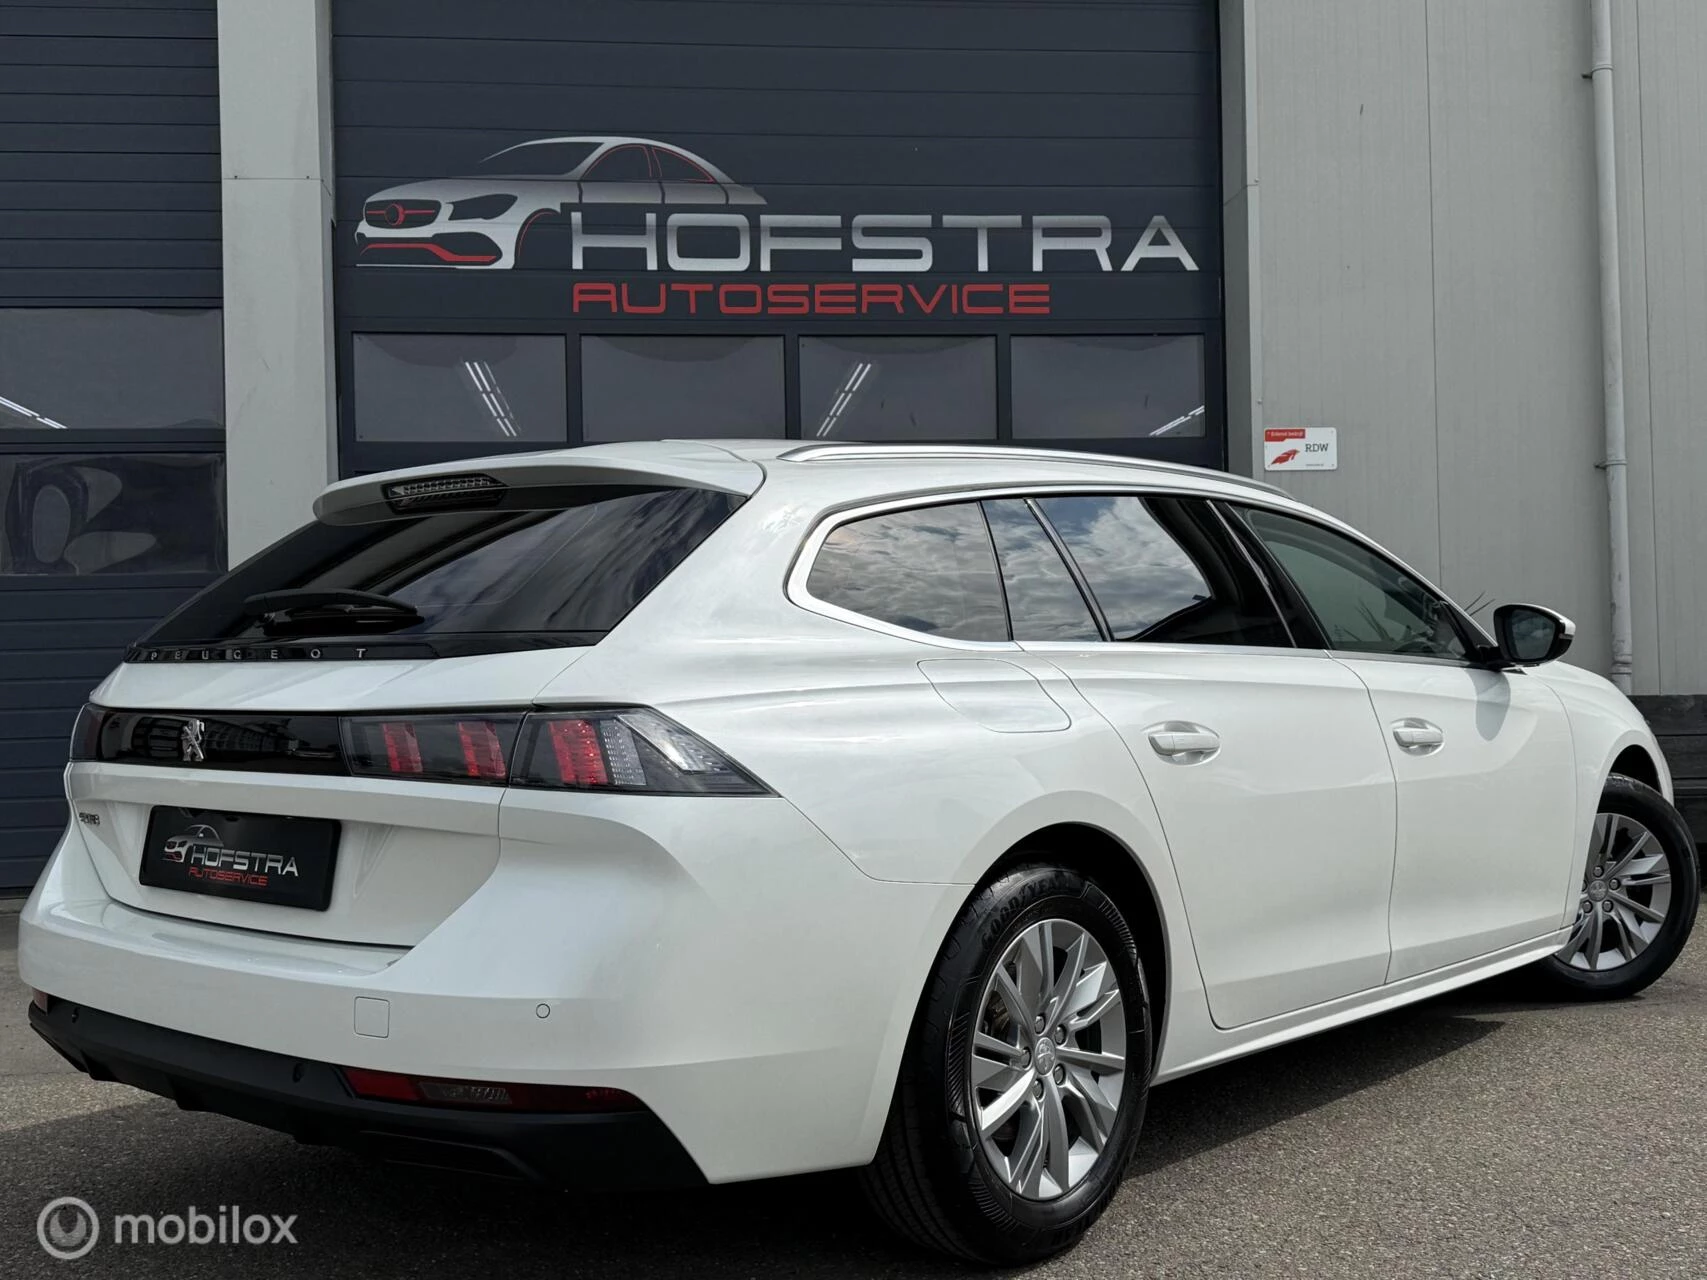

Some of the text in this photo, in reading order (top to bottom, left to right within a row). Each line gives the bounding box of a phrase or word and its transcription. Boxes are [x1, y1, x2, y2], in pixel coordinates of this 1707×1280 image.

[571, 211, 1200, 272] HOFSTRA
[571, 282, 1050, 315] AUTOSERVICE
[1305, 443, 1328, 453] RDW
[150, 648, 367, 660] PEUGEOT
[190, 845, 299, 877] HOFSTRA
[188, 866, 268, 886] AUTOSERVICE
